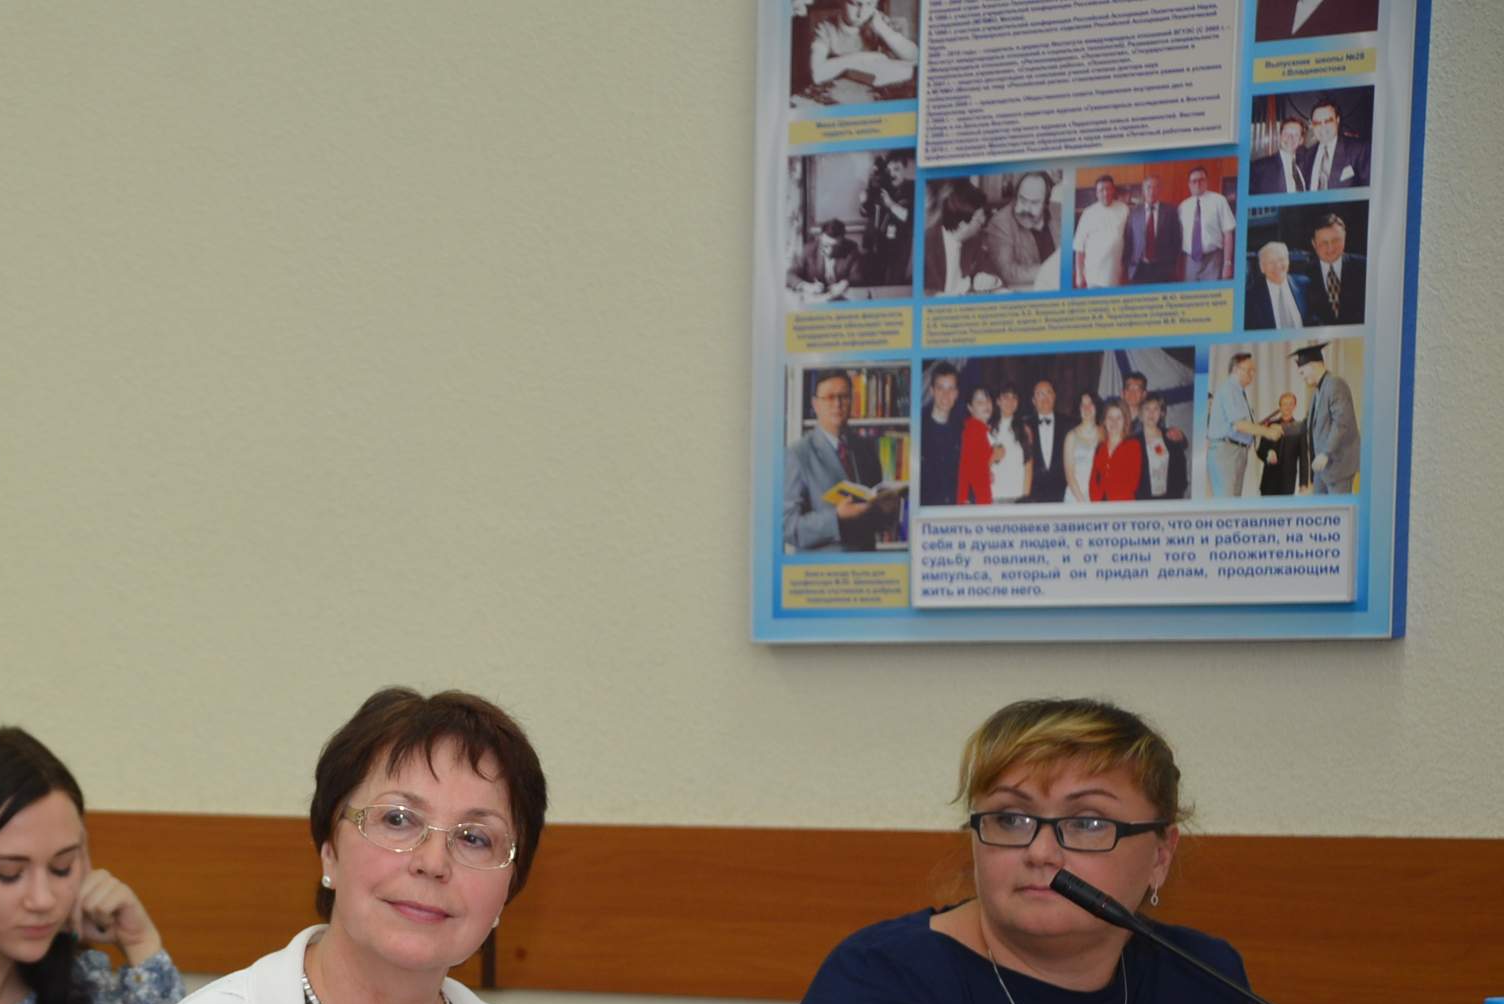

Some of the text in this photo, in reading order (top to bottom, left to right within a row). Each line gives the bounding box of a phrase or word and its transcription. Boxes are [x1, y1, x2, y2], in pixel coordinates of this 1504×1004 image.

[922, 515, 1341, 535] Память о человеке зависит от того, что он оставляет после
[922, 531, 1340, 552] себя в душах людей, с которыми жил и работал, на чью
[922, 548, 1340, 568] судьбу повлиял, и от силы того положительного
[922, 563, 1340, 583] импульса, который он придал делам, продолжающим
[922, 584, 1044, 597] жить и после него.
